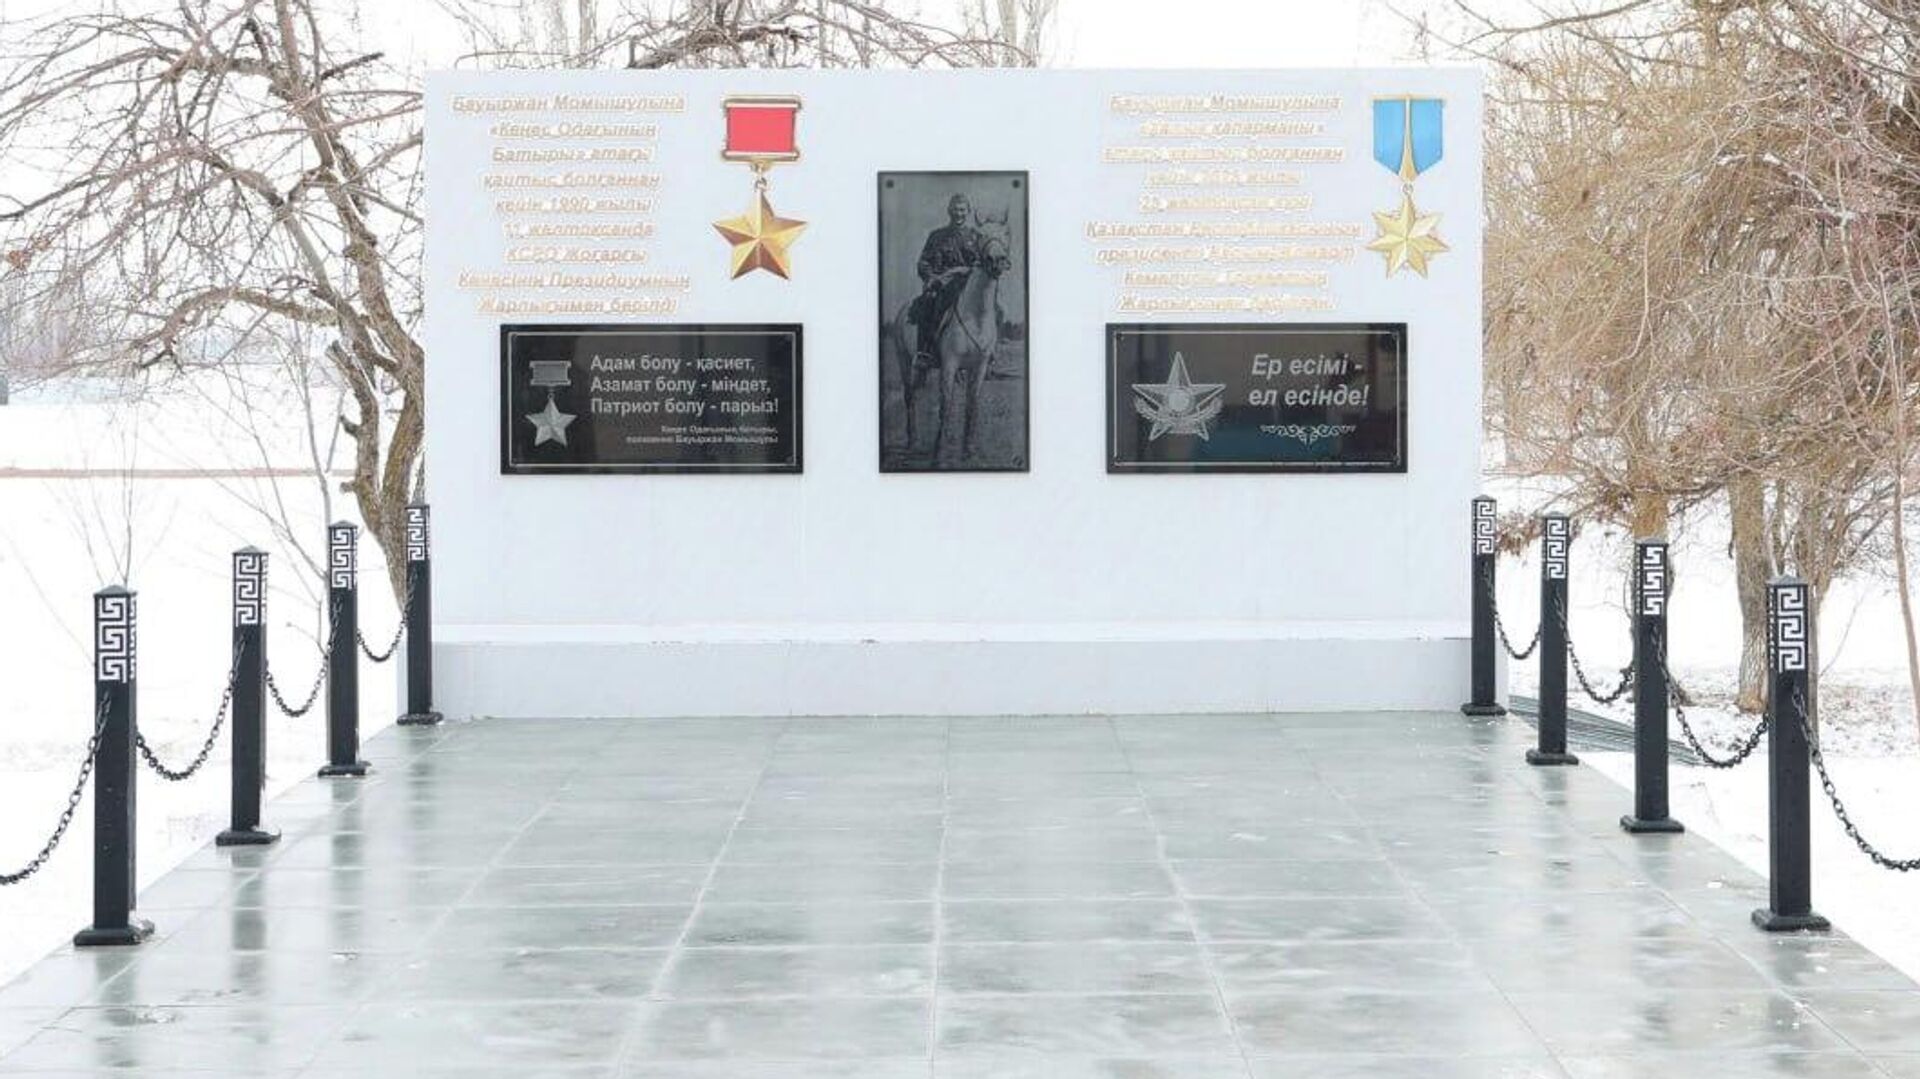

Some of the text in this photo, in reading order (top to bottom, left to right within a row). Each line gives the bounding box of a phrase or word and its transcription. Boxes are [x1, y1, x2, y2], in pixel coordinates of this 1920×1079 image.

[590, 355, 636, 372] Адам
[641, 355, 681, 373] болу
[696, 357, 755, 373] қасиет,
[1251, 354, 1282, 379] Ер
[1289, 354, 1349, 376] есімі
[590, 376, 652, 392] Азамат
[655, 376, 696, 394] болу
[711, 377, 771, 394] міндет,
[1249, 385, 1369, 405] ел есінде!
[590, 398, 660, 416] Патриот
[664, 398, 704, 416] болу
[720, 398, 779, 416] парыз!
